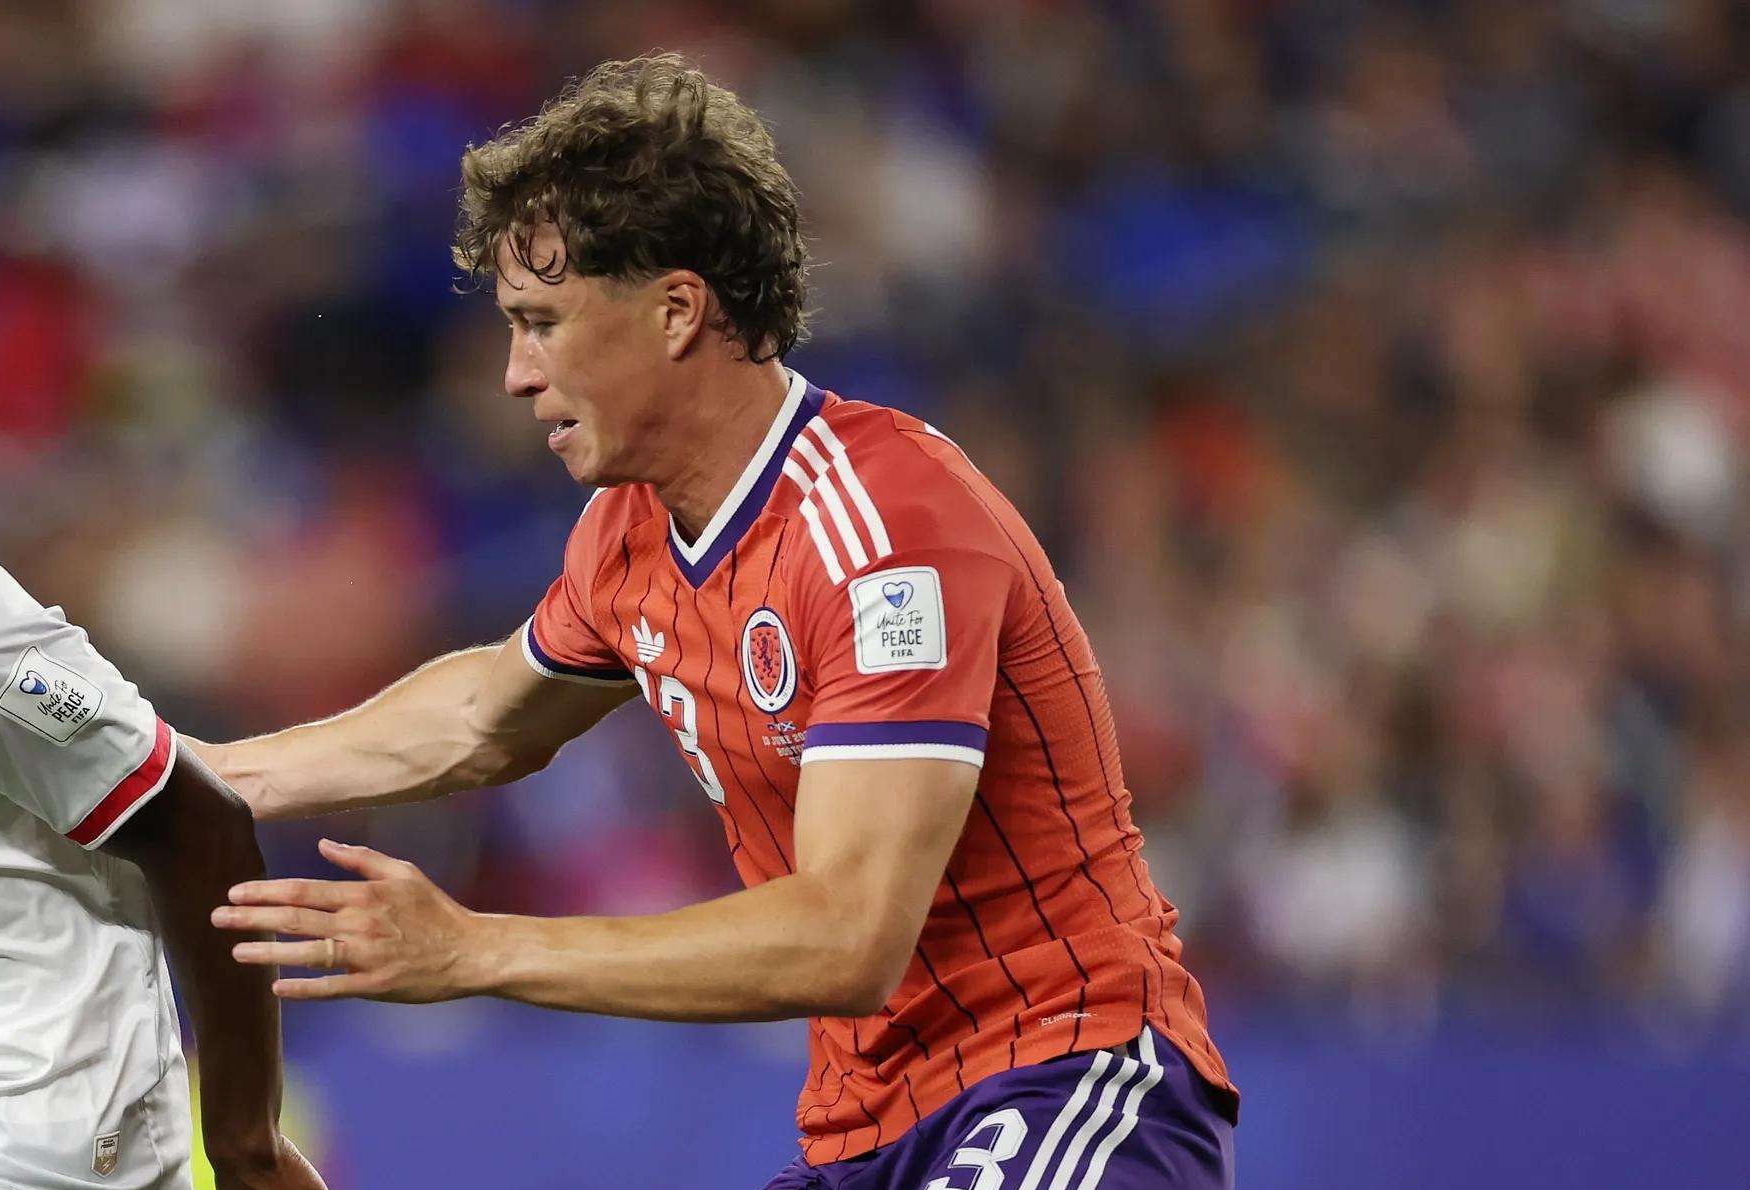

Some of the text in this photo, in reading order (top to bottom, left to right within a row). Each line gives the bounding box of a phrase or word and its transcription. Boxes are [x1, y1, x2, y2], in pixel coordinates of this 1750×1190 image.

[881, 628, 923, 647] PEACE
[891, 648, 914, 658] FIFA
[51, 688, 85, 723] PEACE
[71, 707, 91, 724] FIFA
